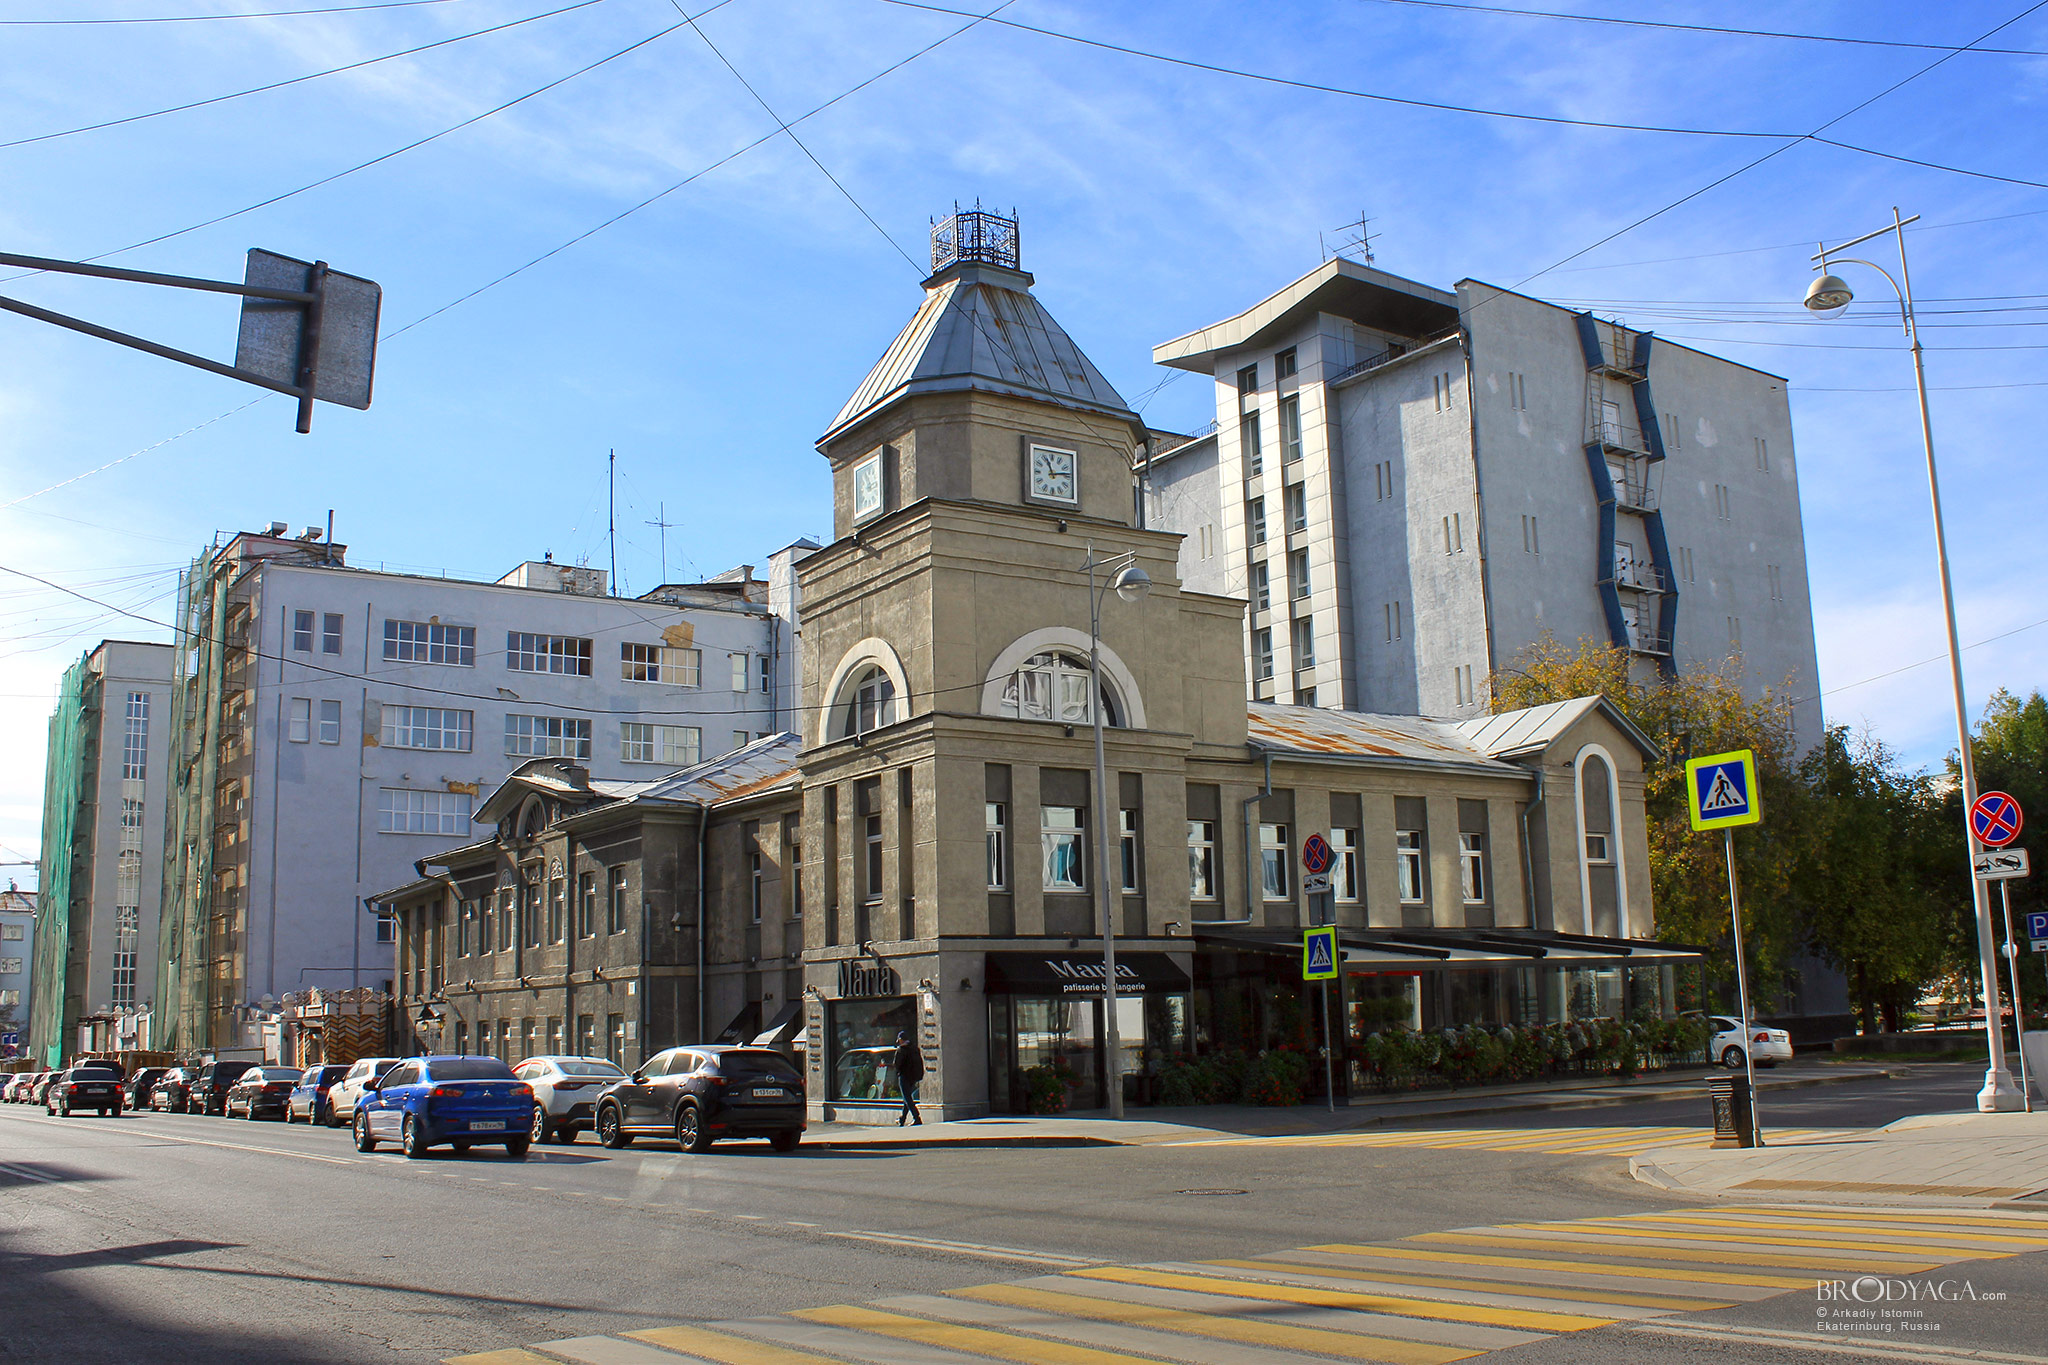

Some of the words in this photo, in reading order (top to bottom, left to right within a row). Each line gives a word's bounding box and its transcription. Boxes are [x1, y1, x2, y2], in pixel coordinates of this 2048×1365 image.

[2033, 916, 2046, 936] P
[838, 960, 894, 998] Maria
[1063, 984, 1100, 992] patisserie
[1101, 983, 1146, 992] blangerie
